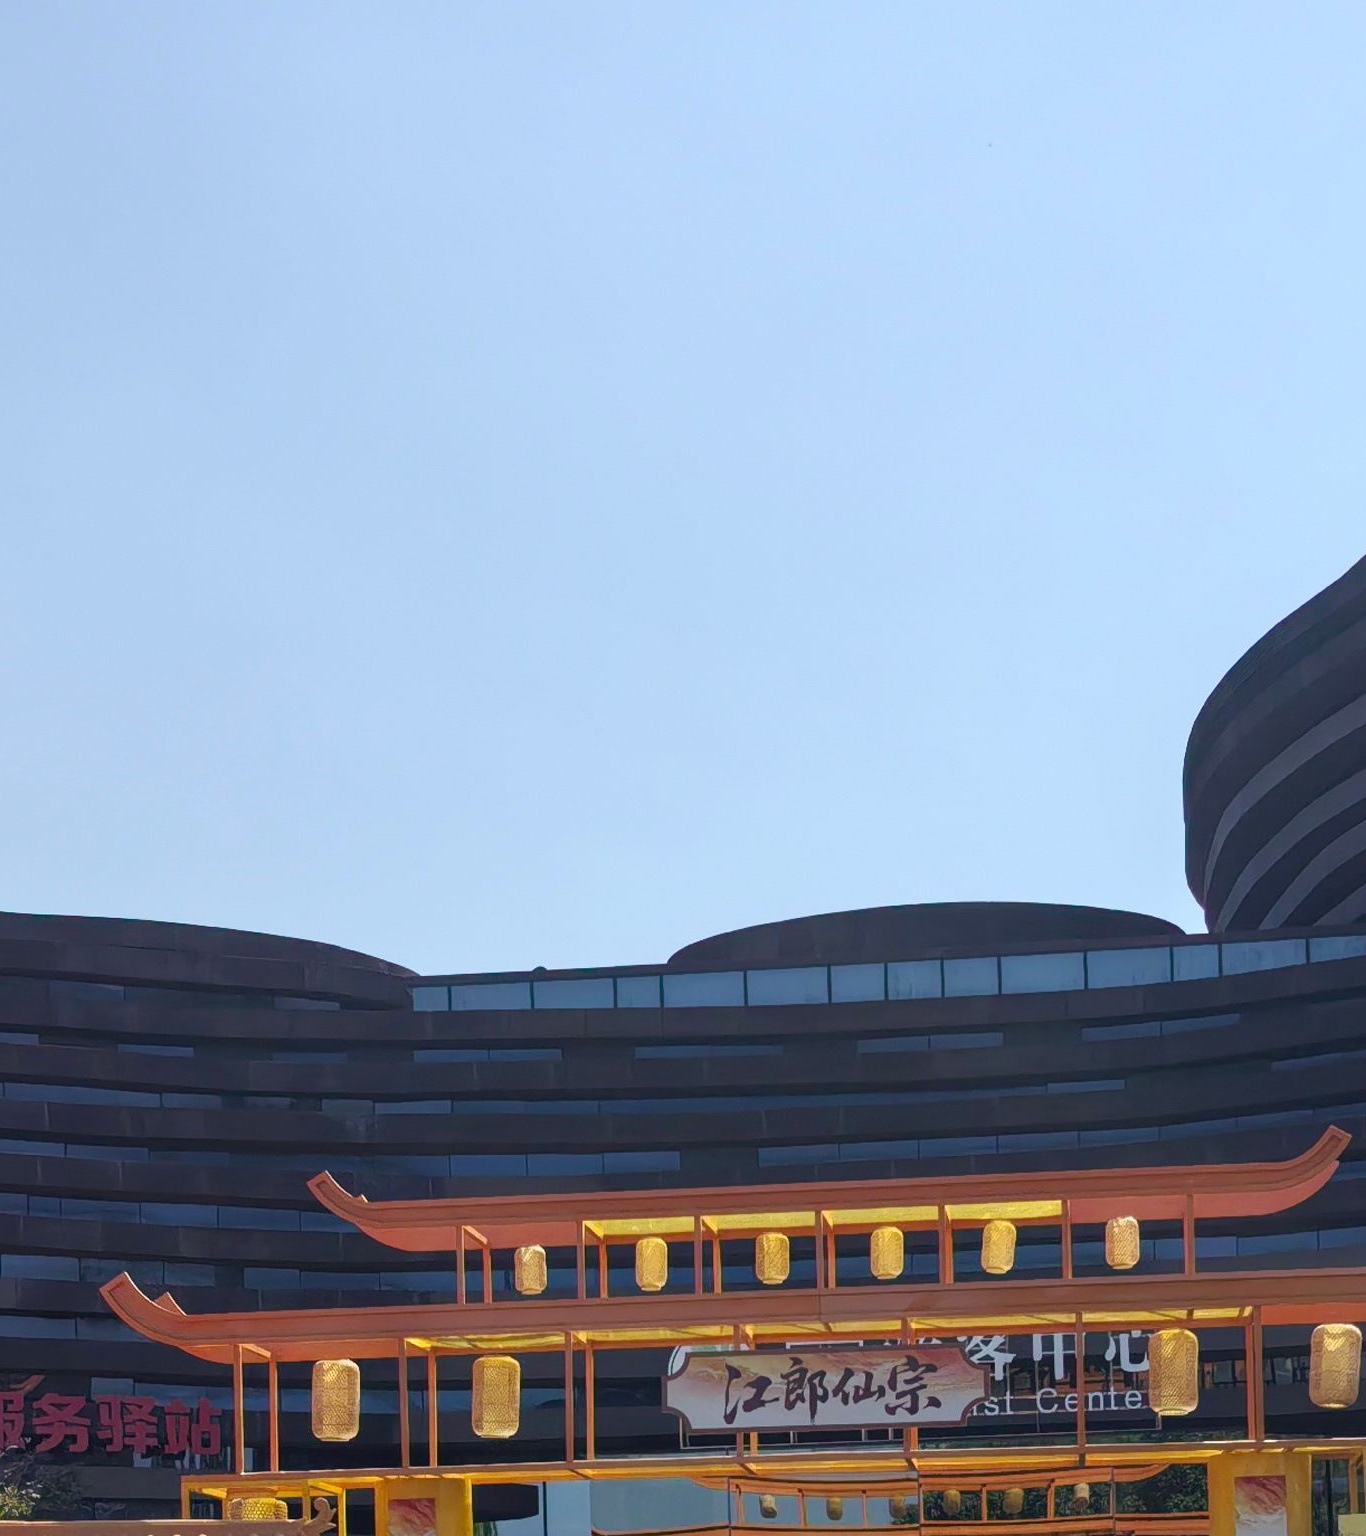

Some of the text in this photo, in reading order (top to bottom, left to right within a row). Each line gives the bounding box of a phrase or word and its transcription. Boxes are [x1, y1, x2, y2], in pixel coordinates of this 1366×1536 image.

[723, 1355, 941, 1425] 江郎仙宗
[1037, 1388, 1143, 1414] Cente
